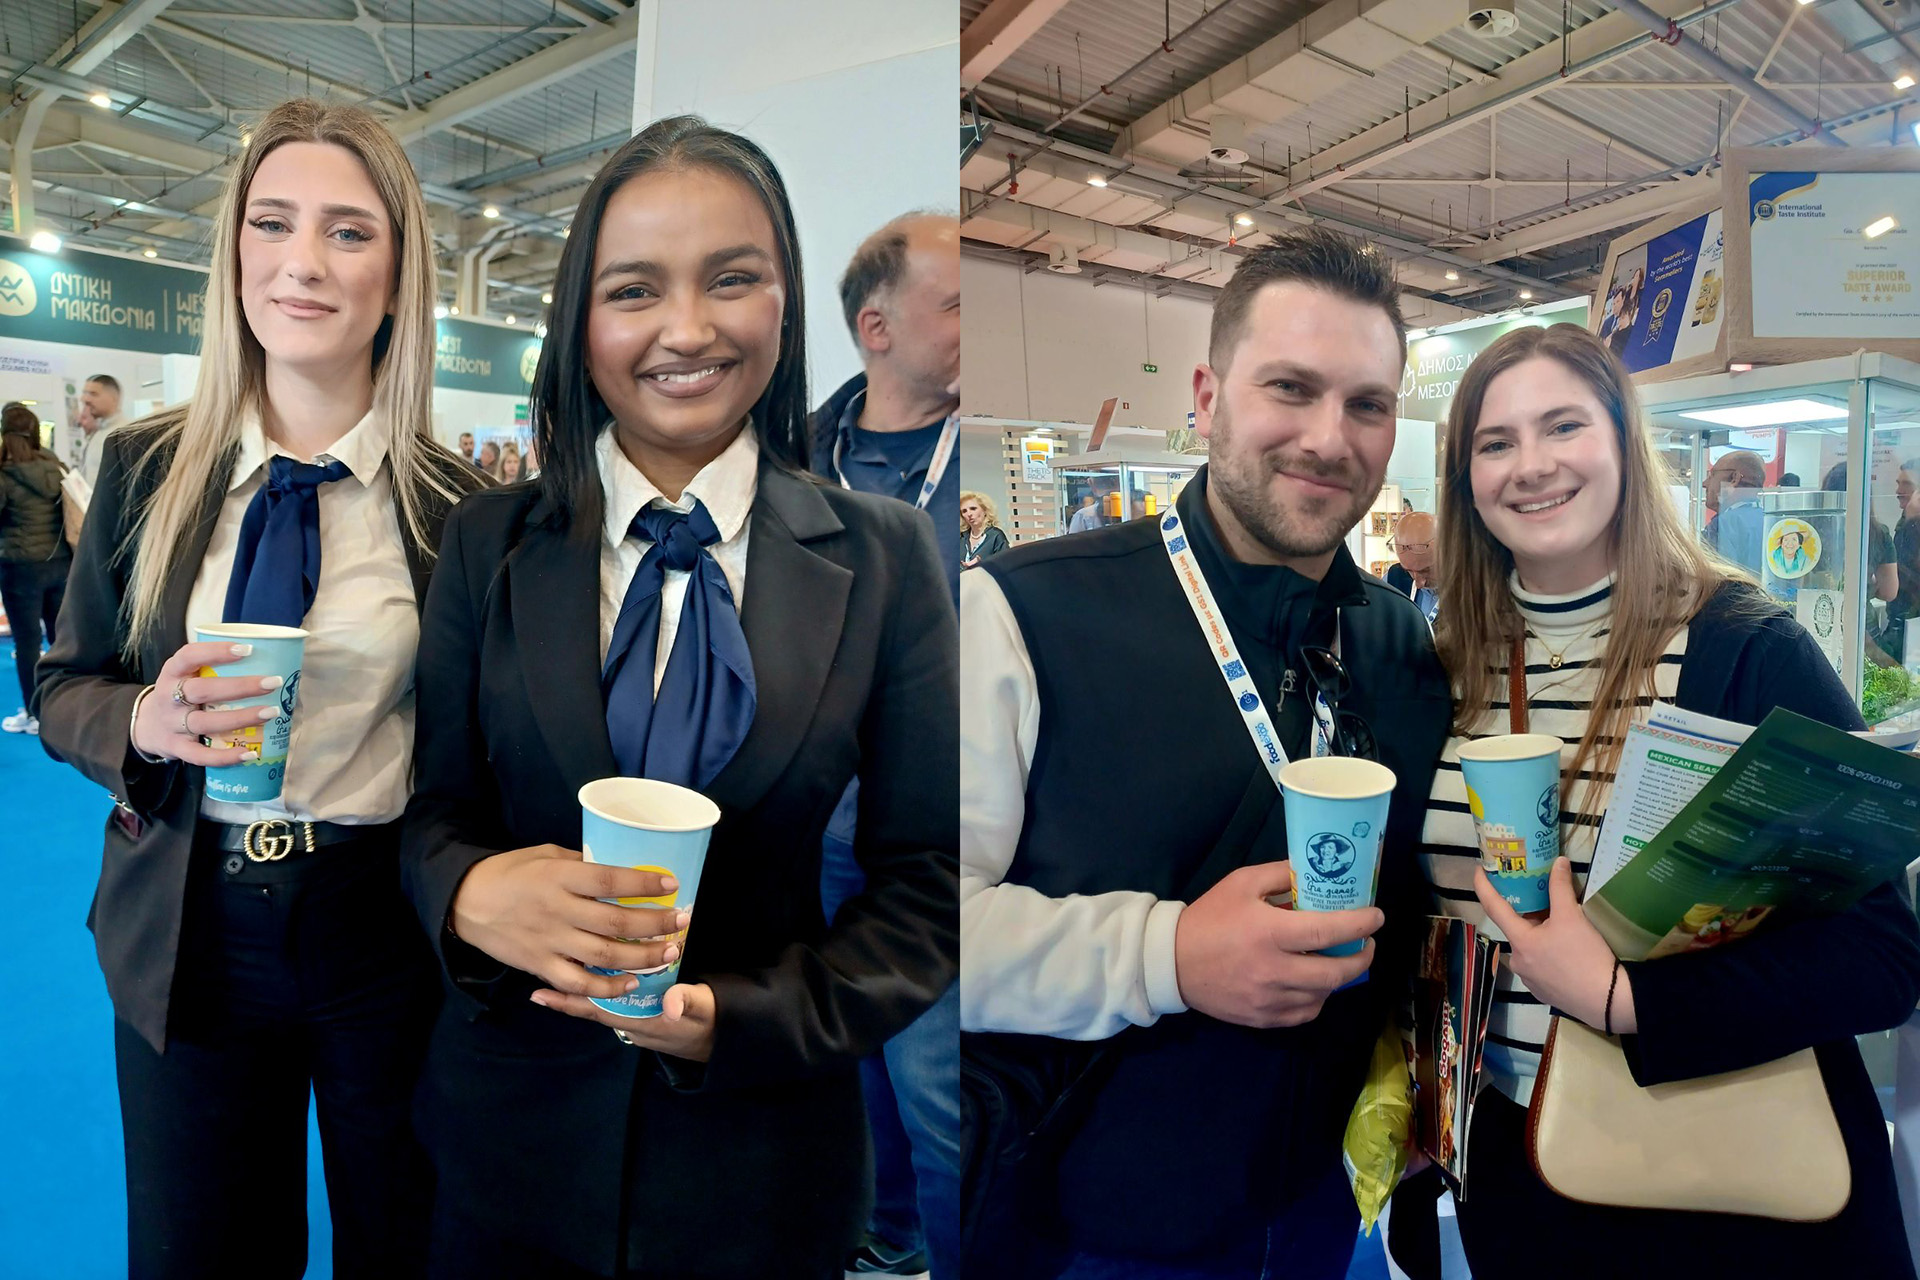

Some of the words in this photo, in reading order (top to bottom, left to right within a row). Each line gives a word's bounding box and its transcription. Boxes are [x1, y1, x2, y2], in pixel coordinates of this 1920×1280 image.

[50, 271, 112, 300] ΔΥΤΙΚΗ
[1847, 270, 1905, 281] SUPERIOR
[1843, 283, 1871, 293] TASTE
[1875, 283, 1911, 293] AWARD
[176, 291, 206, 314] WES
[51, 296, 155, 332] ΜΑΚΕΔΟΝΙΑ
[176, 315, 205, 338] MA
[1417, 355, 1464, 376] ΔΗΜΟΣ
[1417, 381, 1459, 400] ΜΕΣΟΓ
[1179, 554, 1190, 571] Link
[1185, 570, 1200, 594] Digital
[1209, 620, 1223, 645] Codes
[1219, 645, 1229, 658] QR
[1649, 752, 1692, 768] MEXICAN
[1693, 763, 1720, 774] SEAS
[1625, 838, 1645, 848] HOT
